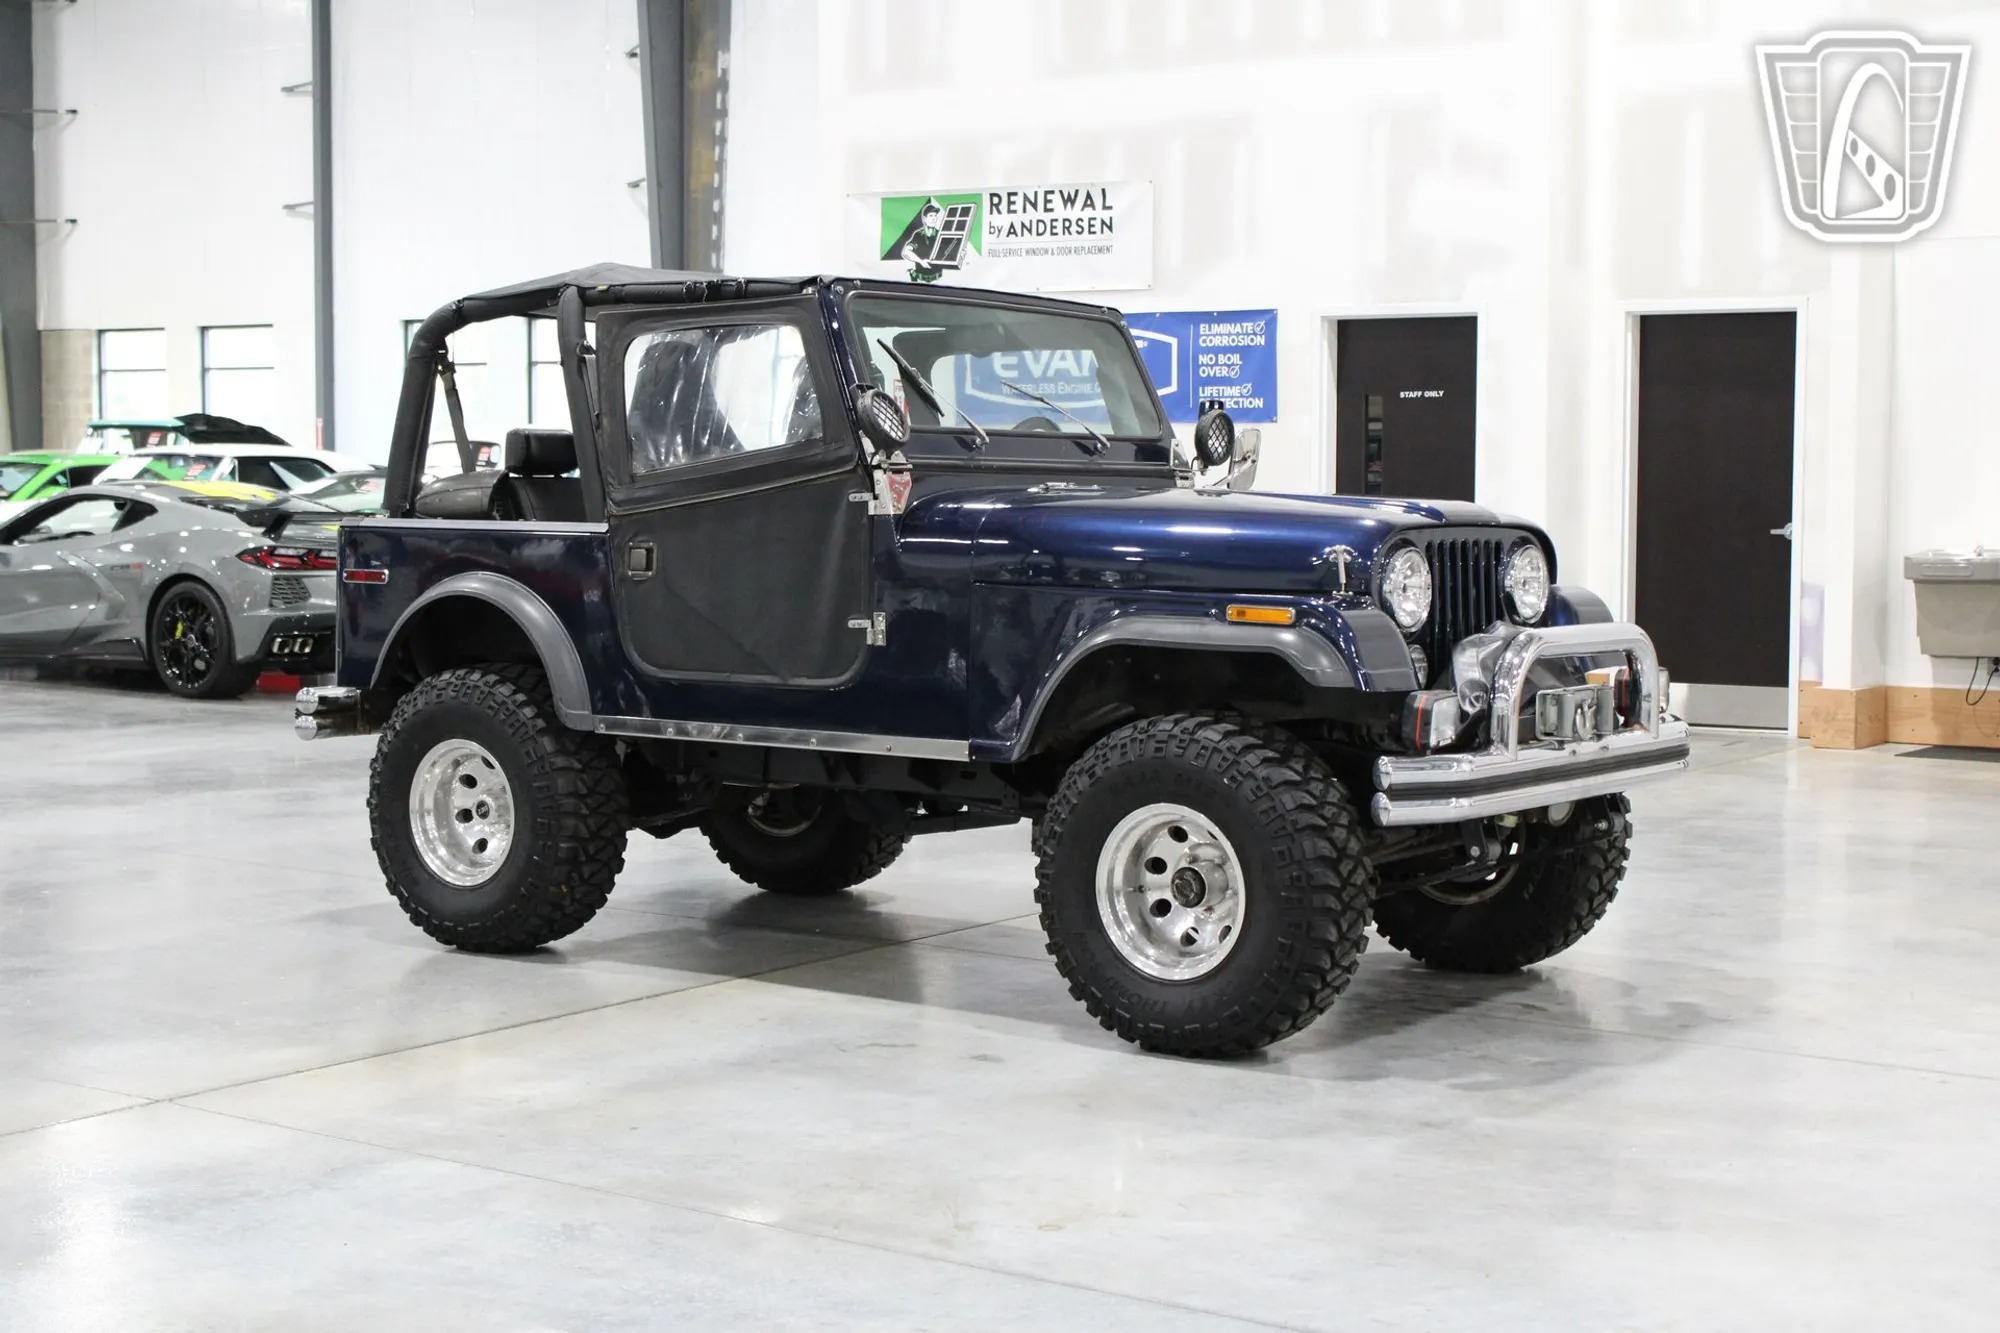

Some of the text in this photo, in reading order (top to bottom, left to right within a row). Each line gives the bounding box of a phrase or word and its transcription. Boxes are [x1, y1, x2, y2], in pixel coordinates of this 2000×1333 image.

[989, 188, 1113, 215] RENEWAL
[988, 216, 1114, 239] by ANDERSEN
[1024, 247, 1049, 257] WINDOW
[1056, 246, 1073, 257] DOOR
[1073, 245, 1113, 256] REPLACEMENT
[1199, 322, 1254, 335] ELIMINATE
[1199, 335, 1265, 347] CORROSION
[1198, 353, 1243, 365] NO BOIL
[1199, 366, 1229, 378] OVER
[1198, 386, 1241, 397] LIFETIME
[1400, 390, 1445, 398] STAFF ONLY
[1199, 398, 1264, 409] ECTION
